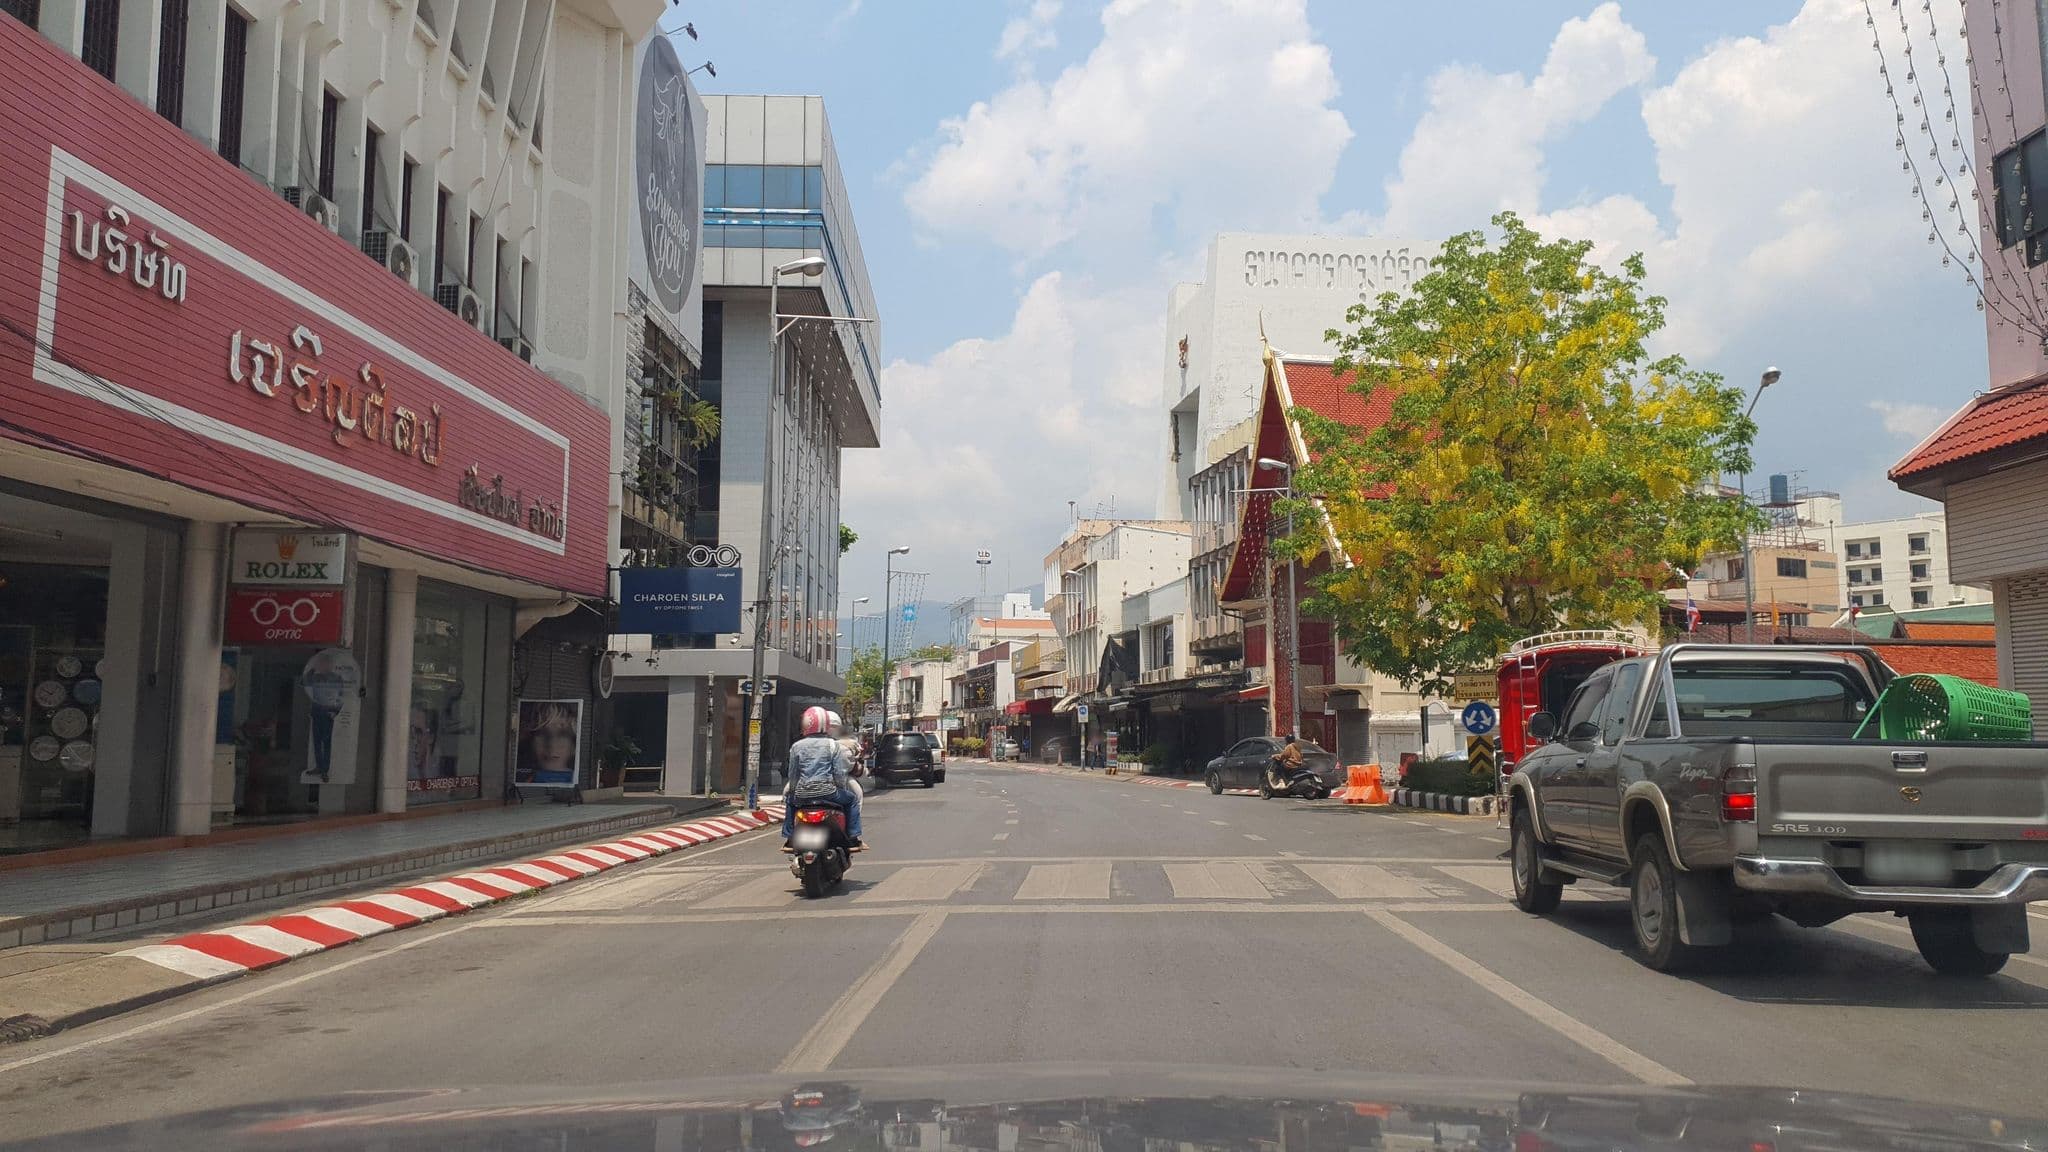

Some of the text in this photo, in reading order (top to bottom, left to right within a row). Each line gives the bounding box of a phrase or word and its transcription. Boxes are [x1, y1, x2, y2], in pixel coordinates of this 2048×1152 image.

[68, 204, 187, 303] บริษัท
[1244, 247, 1429, 300] ธนาคารกรุงศรีอ
[229, 323, 447, 467] เจริญศิลป์
[246, 561, 329, 579] ROLEX
[633, 593, 725, 602] CHAROEN SILPA
[265, 628, 303, 640] OPTIC
[1770, 823, 1809, 833] SR5
